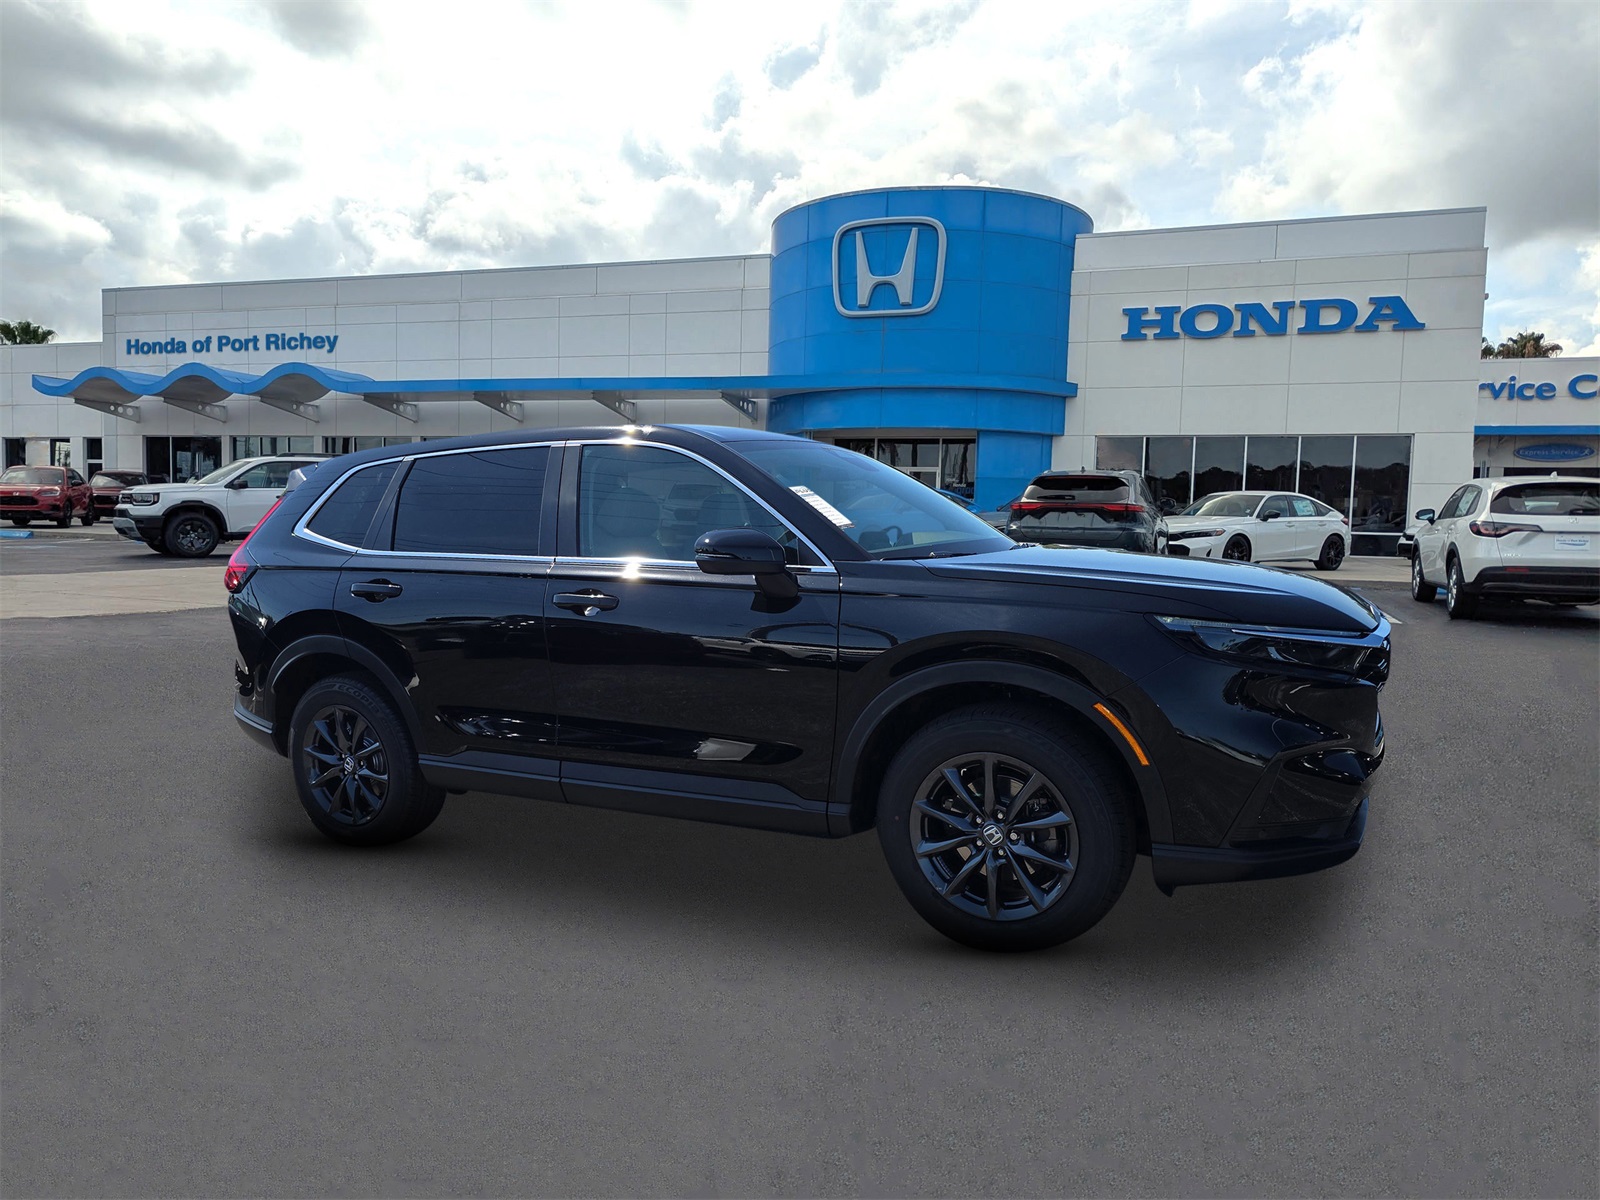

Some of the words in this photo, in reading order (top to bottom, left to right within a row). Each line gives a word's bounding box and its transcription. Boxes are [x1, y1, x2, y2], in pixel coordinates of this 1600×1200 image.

[1121, 295, 1425, 340] HONDA
[126, 337, 187, 355] Honda
[192, 336, 212, 353] of
[217, 335, 260, 352] Port
[265, 333, 339, 353] Richey
[1568, 374, 1600, 400] C
[1519, 449, 1549, 457] Express
[1550, 449, 1579, 457] Service
